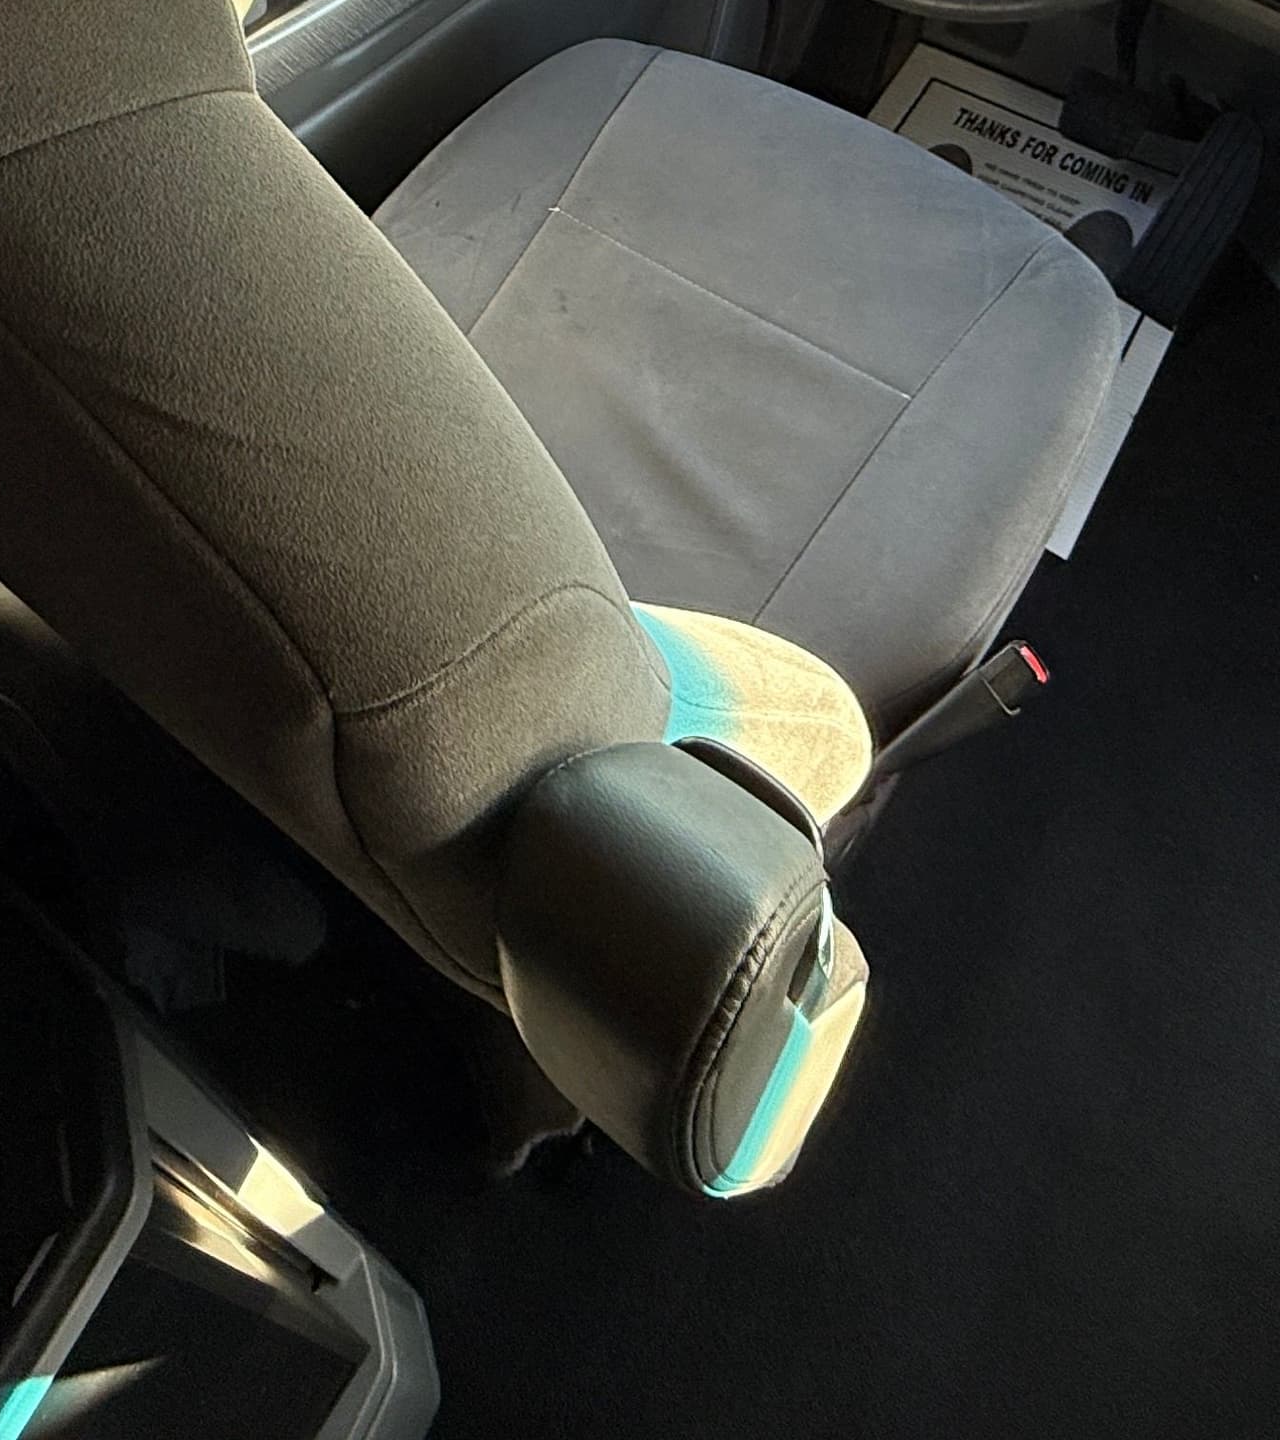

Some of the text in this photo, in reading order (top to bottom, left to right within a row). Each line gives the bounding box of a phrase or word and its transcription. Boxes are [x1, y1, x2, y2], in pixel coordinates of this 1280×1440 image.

[953, 108, 1021, 148] THANKS
[1020, 136, 1059, 165] FOR
[1058, 152, 1130, 194] COMING
[1129, 179, 1155, 204] IN
